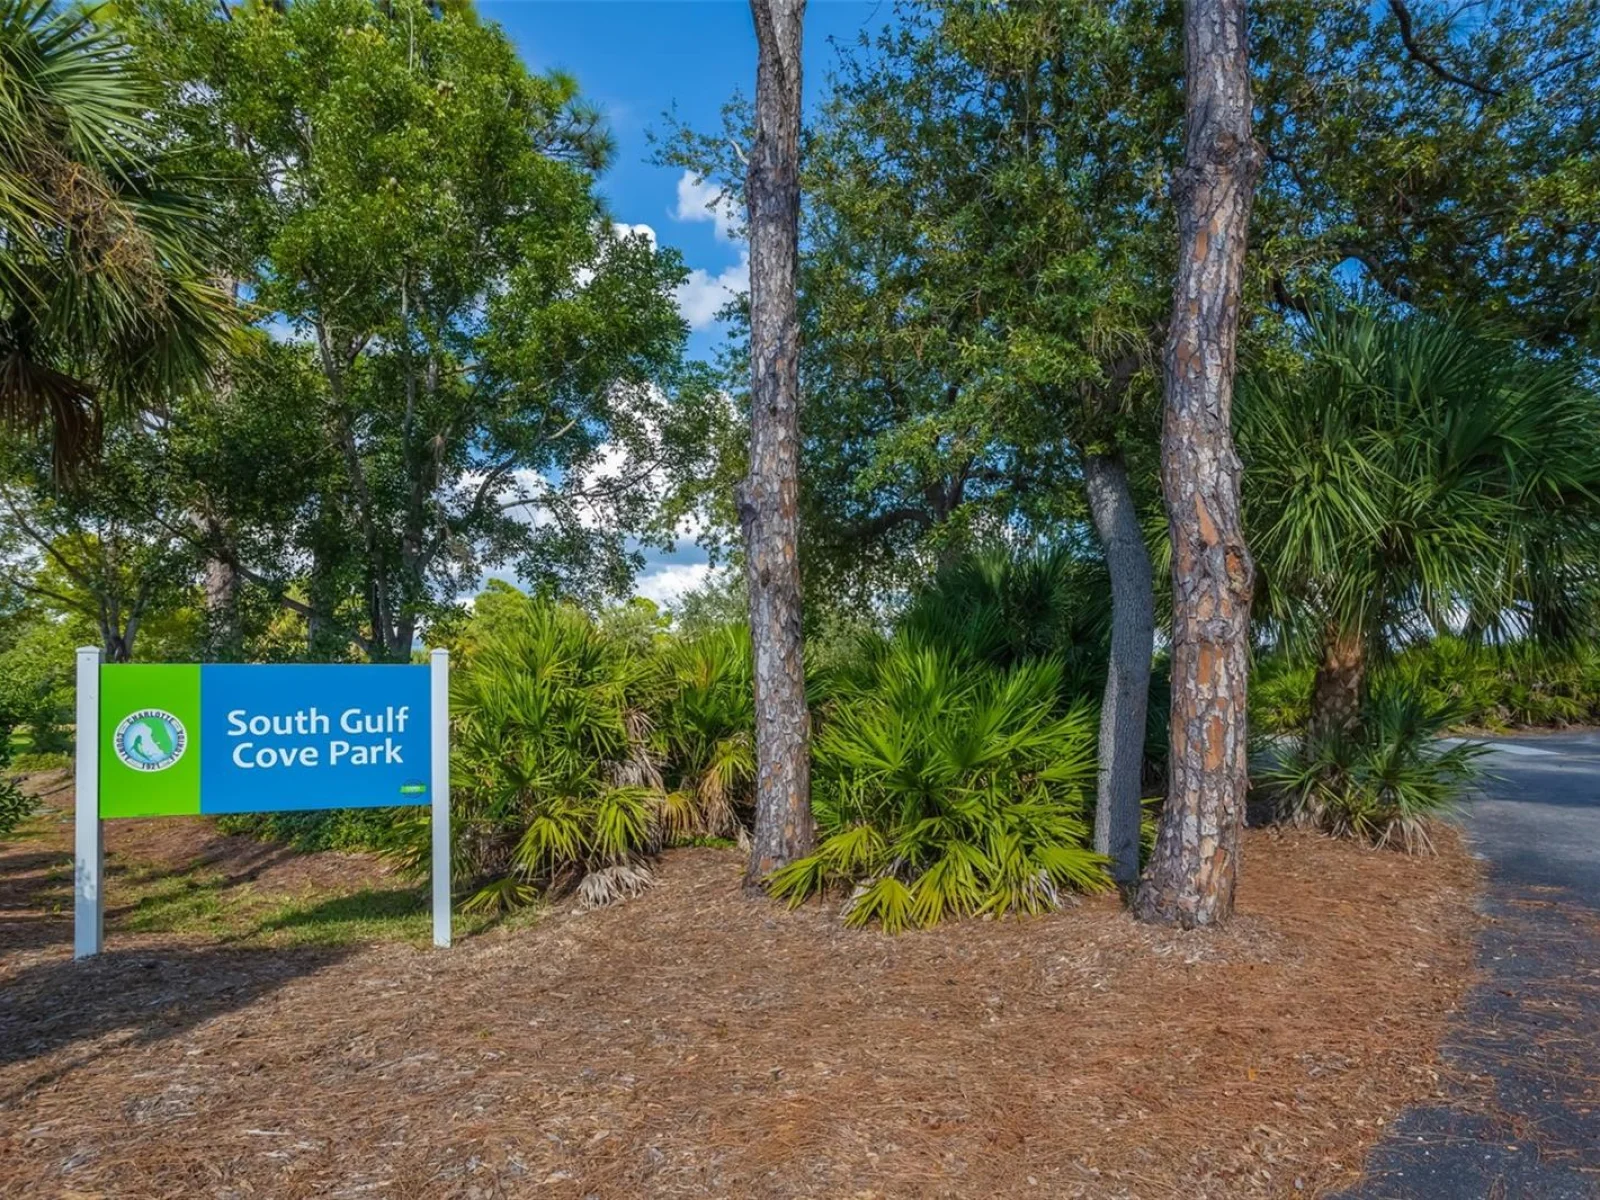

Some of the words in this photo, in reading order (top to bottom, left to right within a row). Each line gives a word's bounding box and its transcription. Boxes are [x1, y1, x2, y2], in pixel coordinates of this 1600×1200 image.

[126, 710, 175, 725] CHARLOTTE
[227, 707, 330, 736] South
[340, 706, 409, 734] Gulf
[232, 743, 319, 768] Cove
[330, 738, 403, 765] Park
